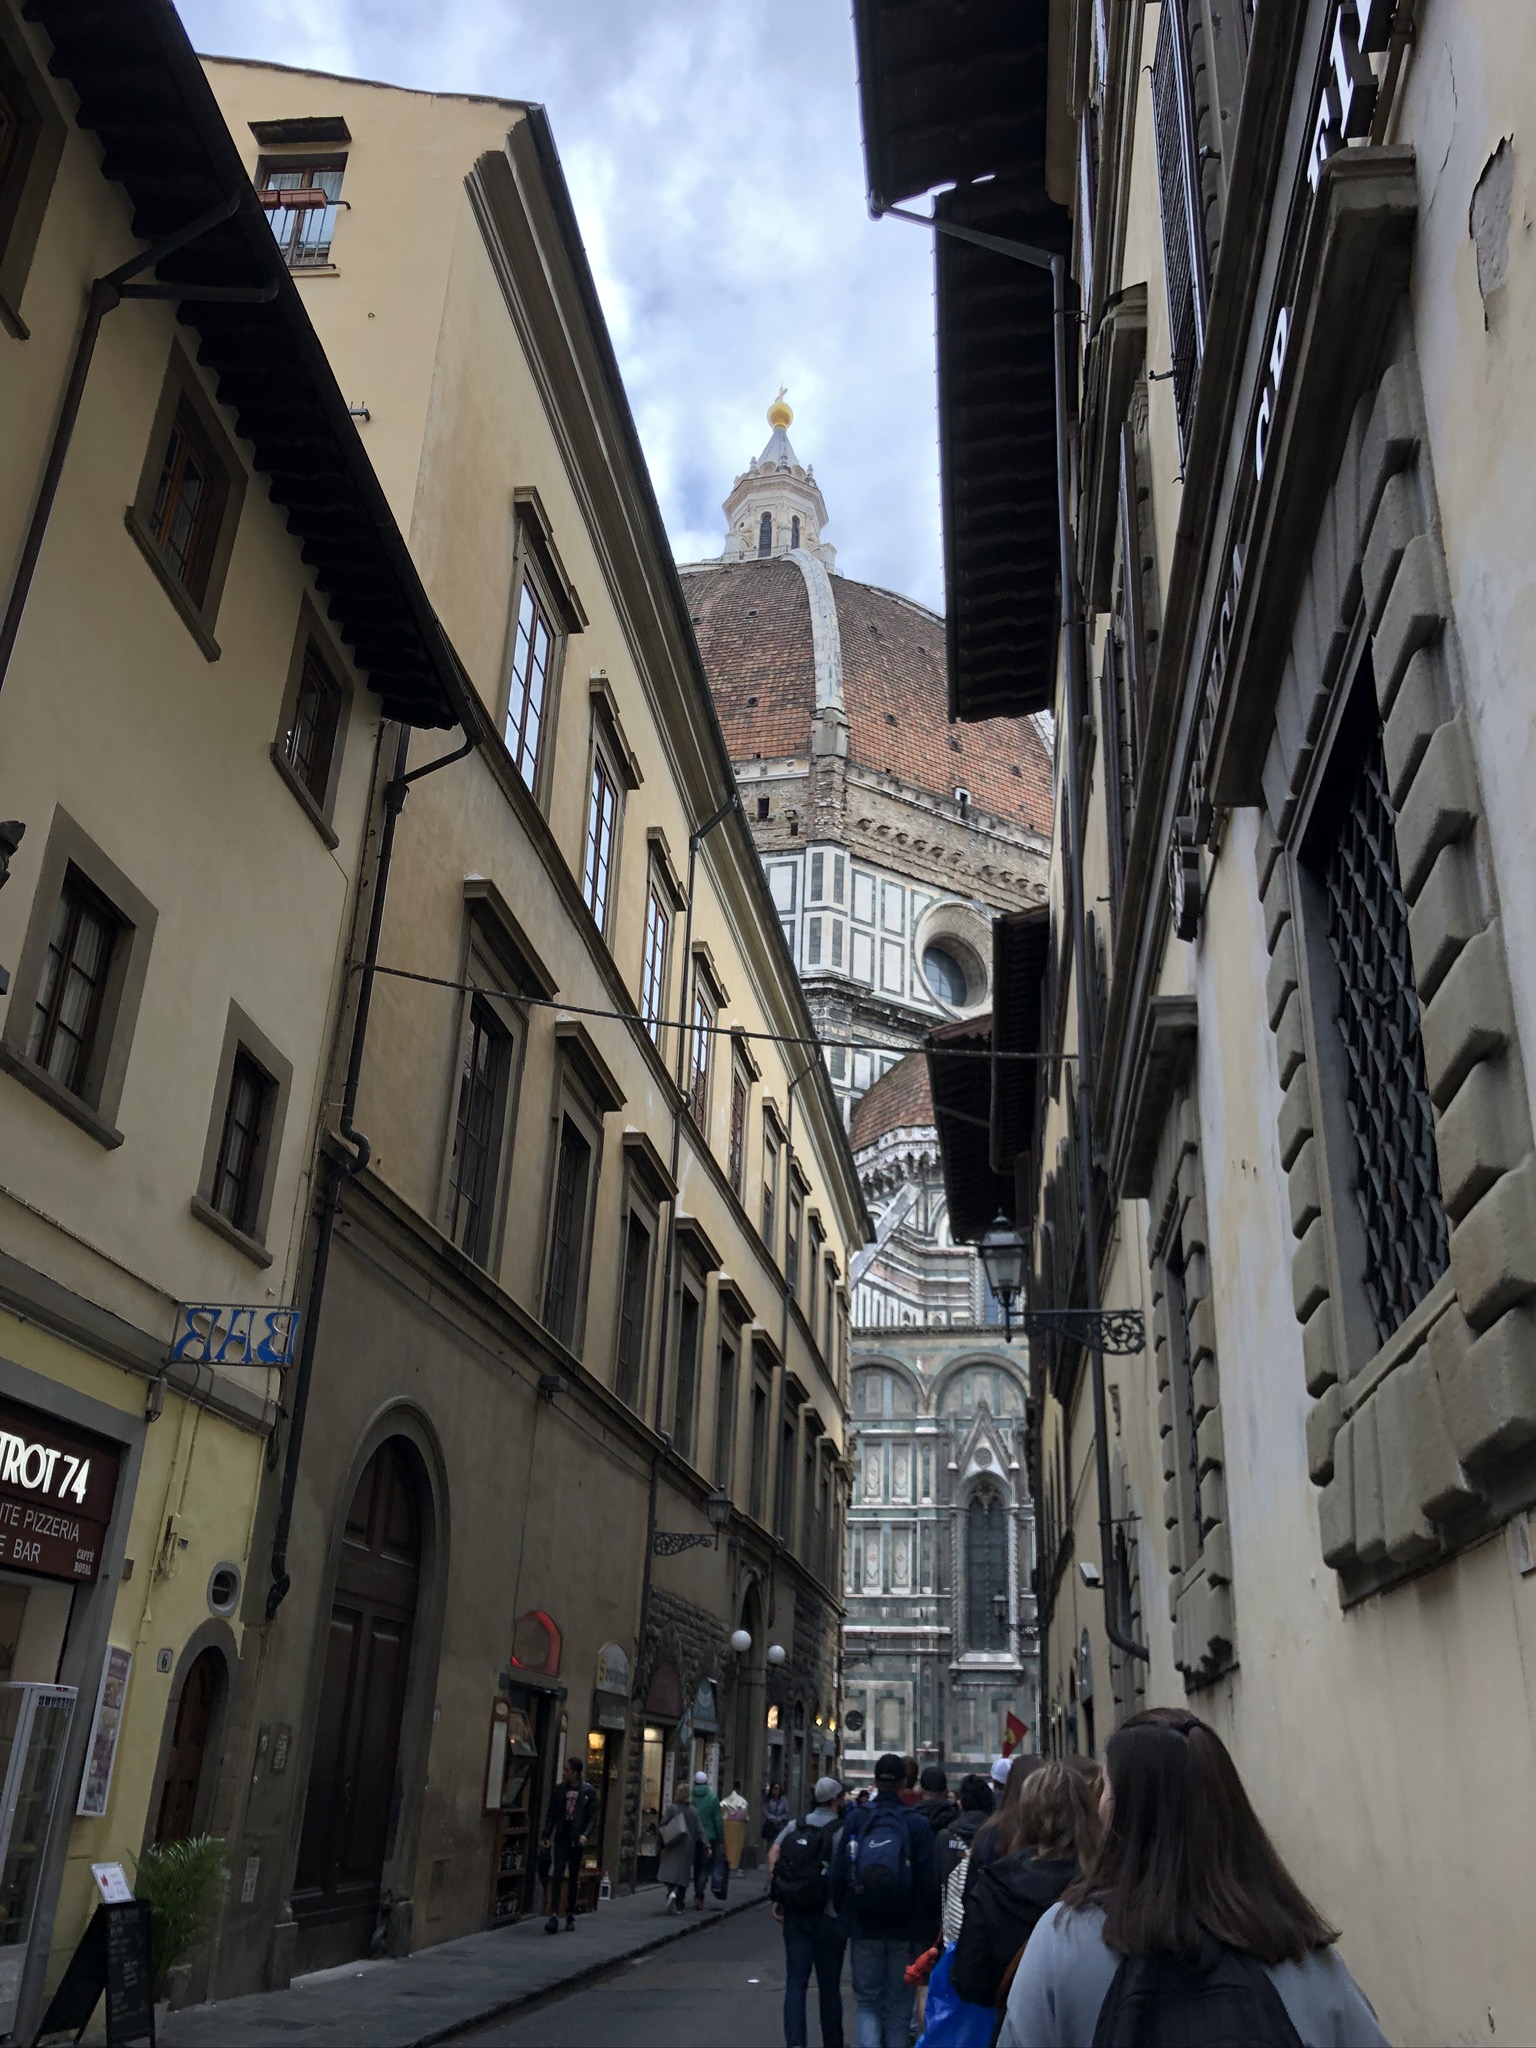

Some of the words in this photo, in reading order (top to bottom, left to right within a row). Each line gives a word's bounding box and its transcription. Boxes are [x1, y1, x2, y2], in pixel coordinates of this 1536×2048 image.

[58, 1455, 90, 1504] 74
[23, 1509, 80, 1542] PIZZERIA
[13, 1539, 41, 1563] BAR
[161, 1653, 168, 1669] 6
